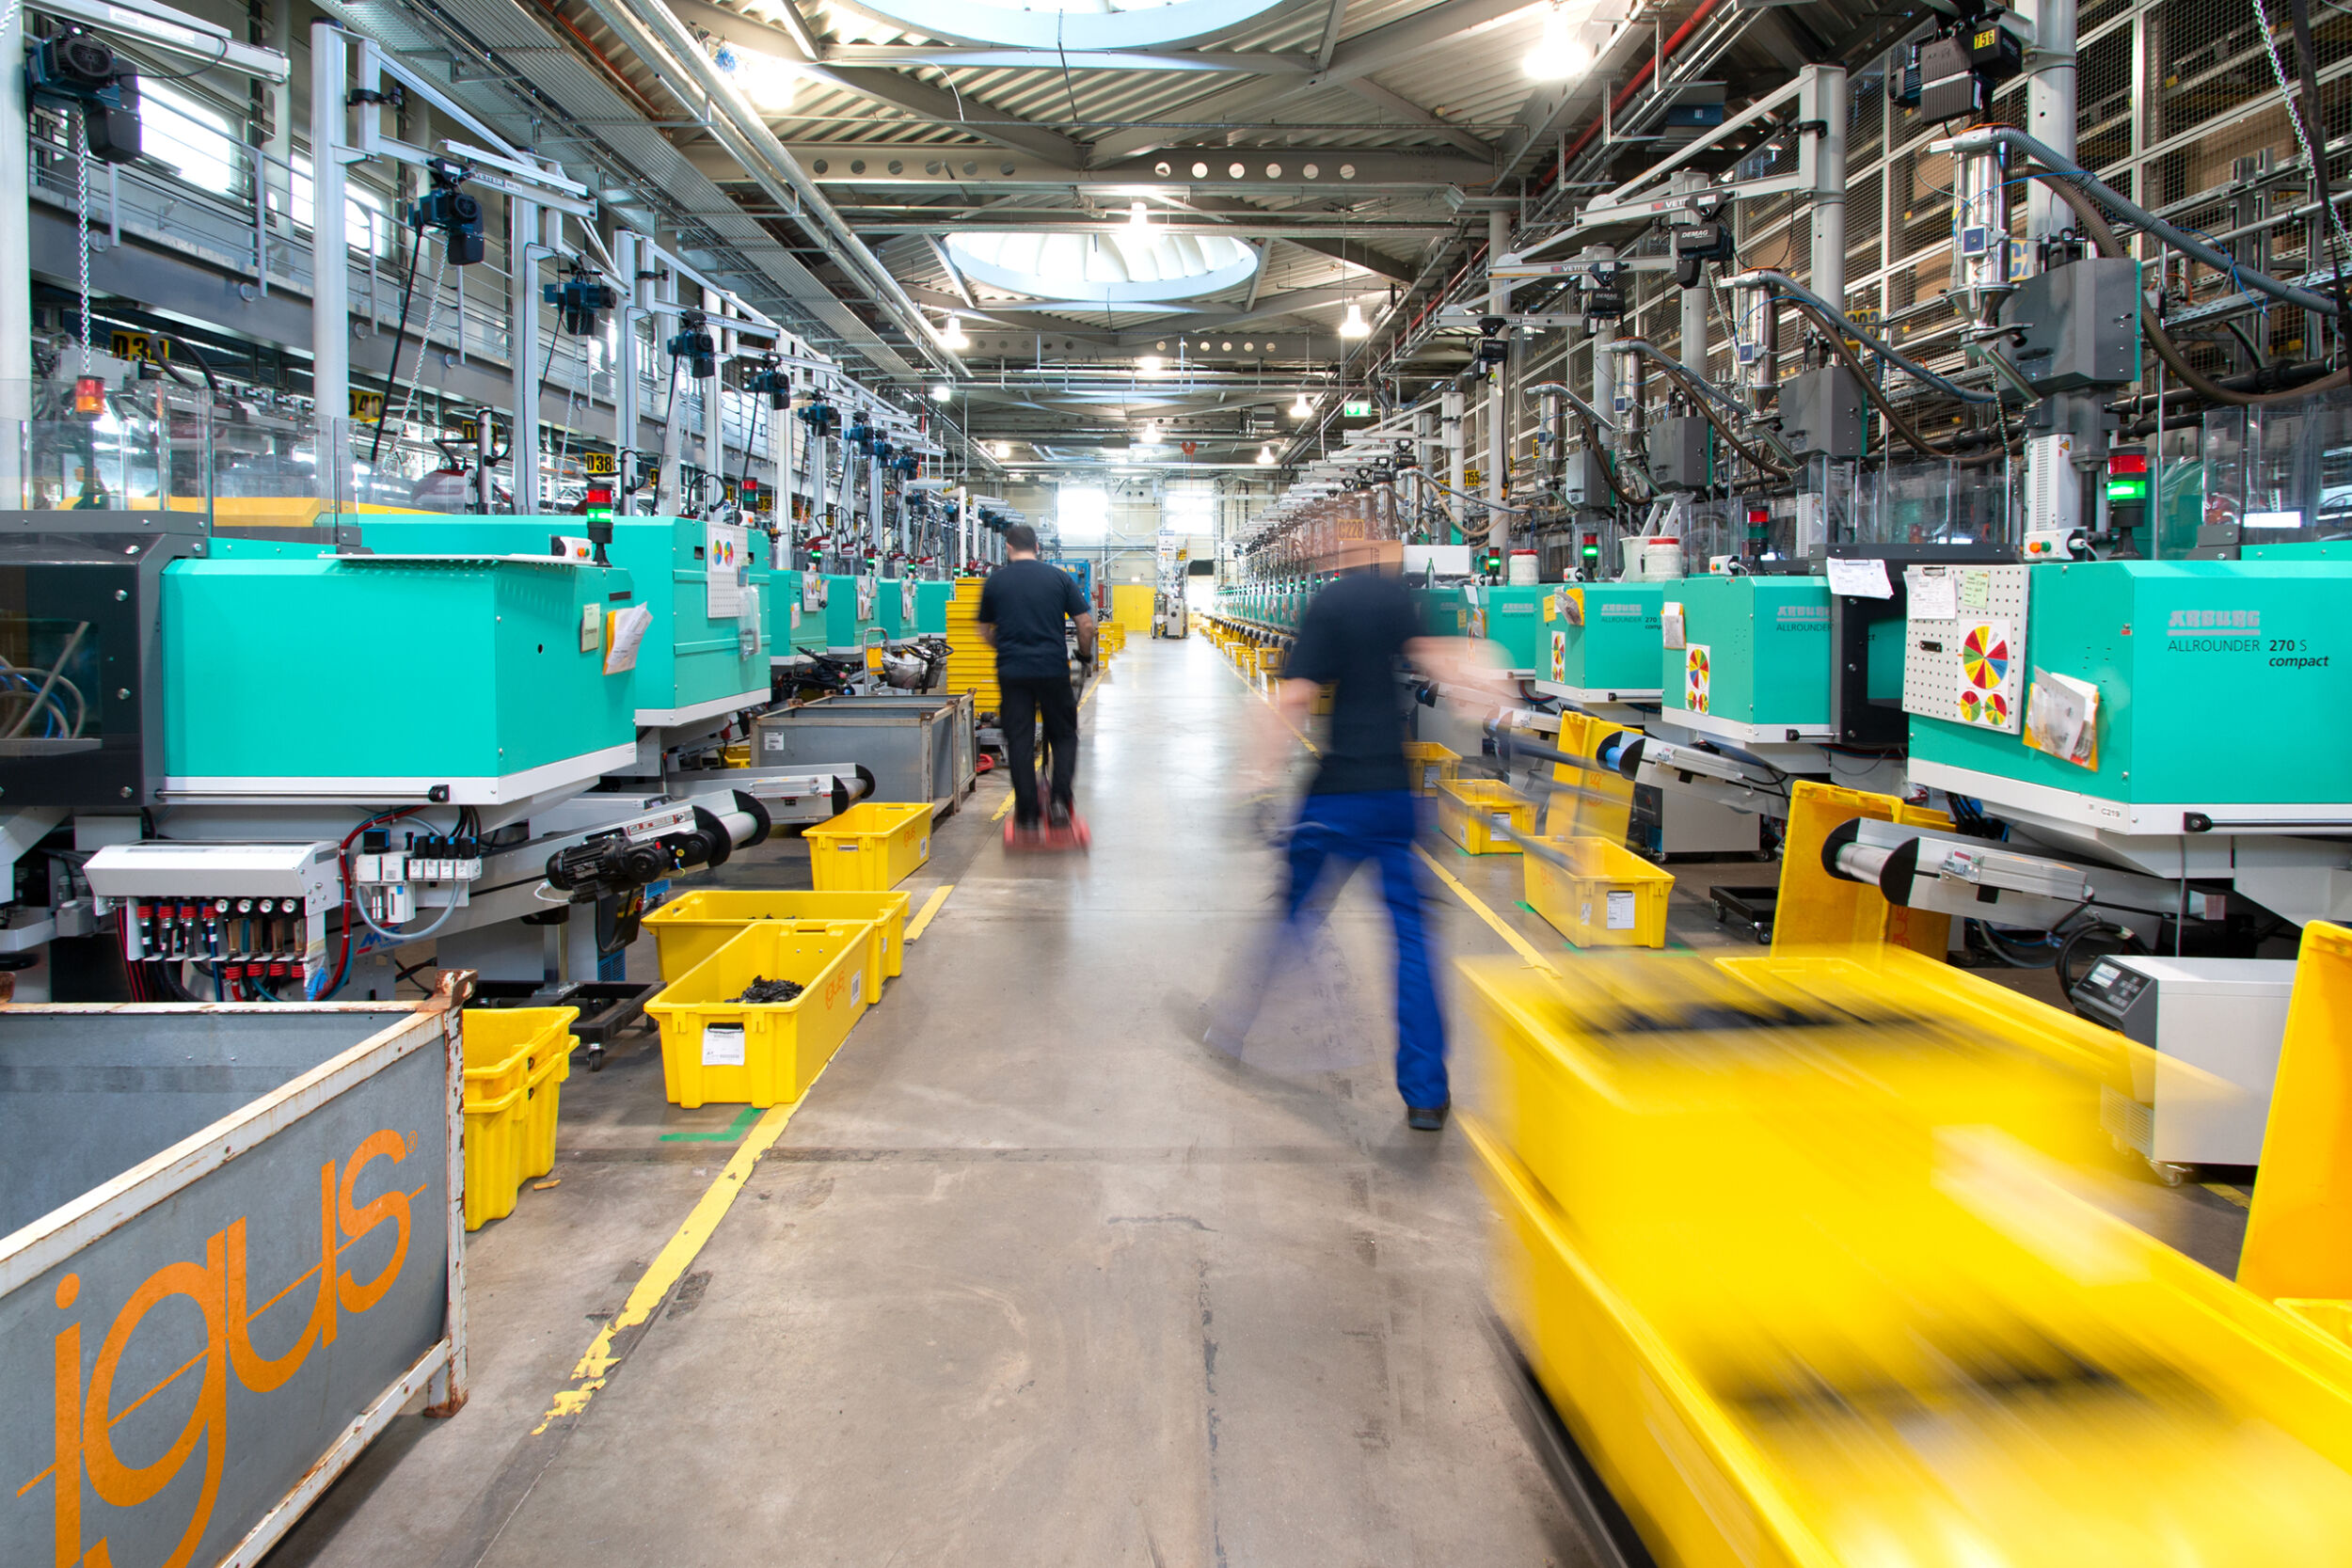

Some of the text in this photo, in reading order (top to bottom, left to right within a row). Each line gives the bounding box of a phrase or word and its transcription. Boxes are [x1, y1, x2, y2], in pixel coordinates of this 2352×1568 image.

[1976, 31, 1994, 48] 756
[474, 171, 504, 188] VETTER
[1681, 230, 1708, 239] DEMAG
[586, 453, 613, 472] D38
[1339, 520, 1363, 539] C228
[2168, 610, 2260, 628] ARBURG
[2167, 640, 2308, 652] ALLROUNDER 270 S
[2268, 656, 2329, 670] compact
